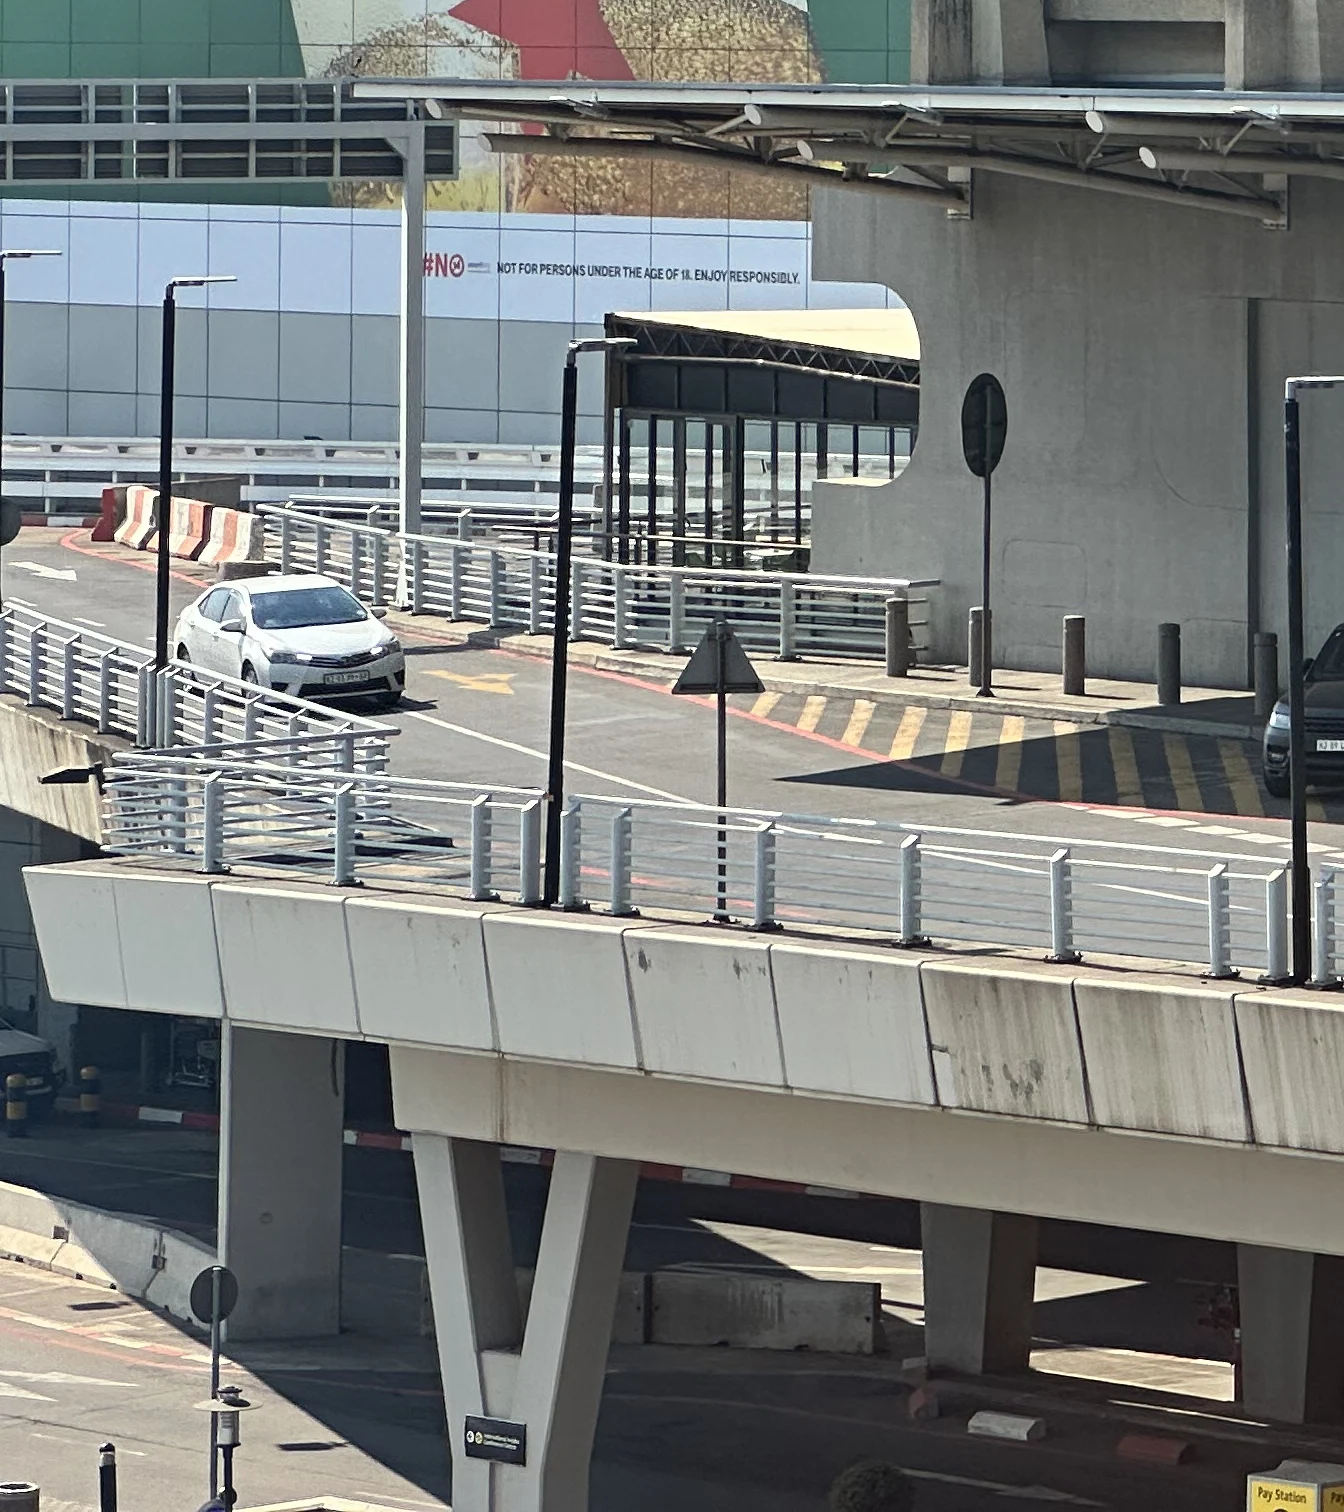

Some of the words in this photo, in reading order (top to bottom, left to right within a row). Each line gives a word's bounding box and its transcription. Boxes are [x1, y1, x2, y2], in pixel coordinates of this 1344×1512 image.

[497, 261, 518, 274] NOT
[519, 262, 539, 275] FOR
[540, 262, 586, 276] PERSONS
[587, 264, 622, 278] UNDER
[623, 265, 642, 279] THE
[643, 266, 664, 280] AGE
[665, 268, 680, 280] OF
[694, 269, 727, 282] ENJOY
[729, 270, 801, 285] RESPONSIBLY.
[1258, 1487, 1273, 1503] Pay
[1275, 1489, 1306, 1503] Station
